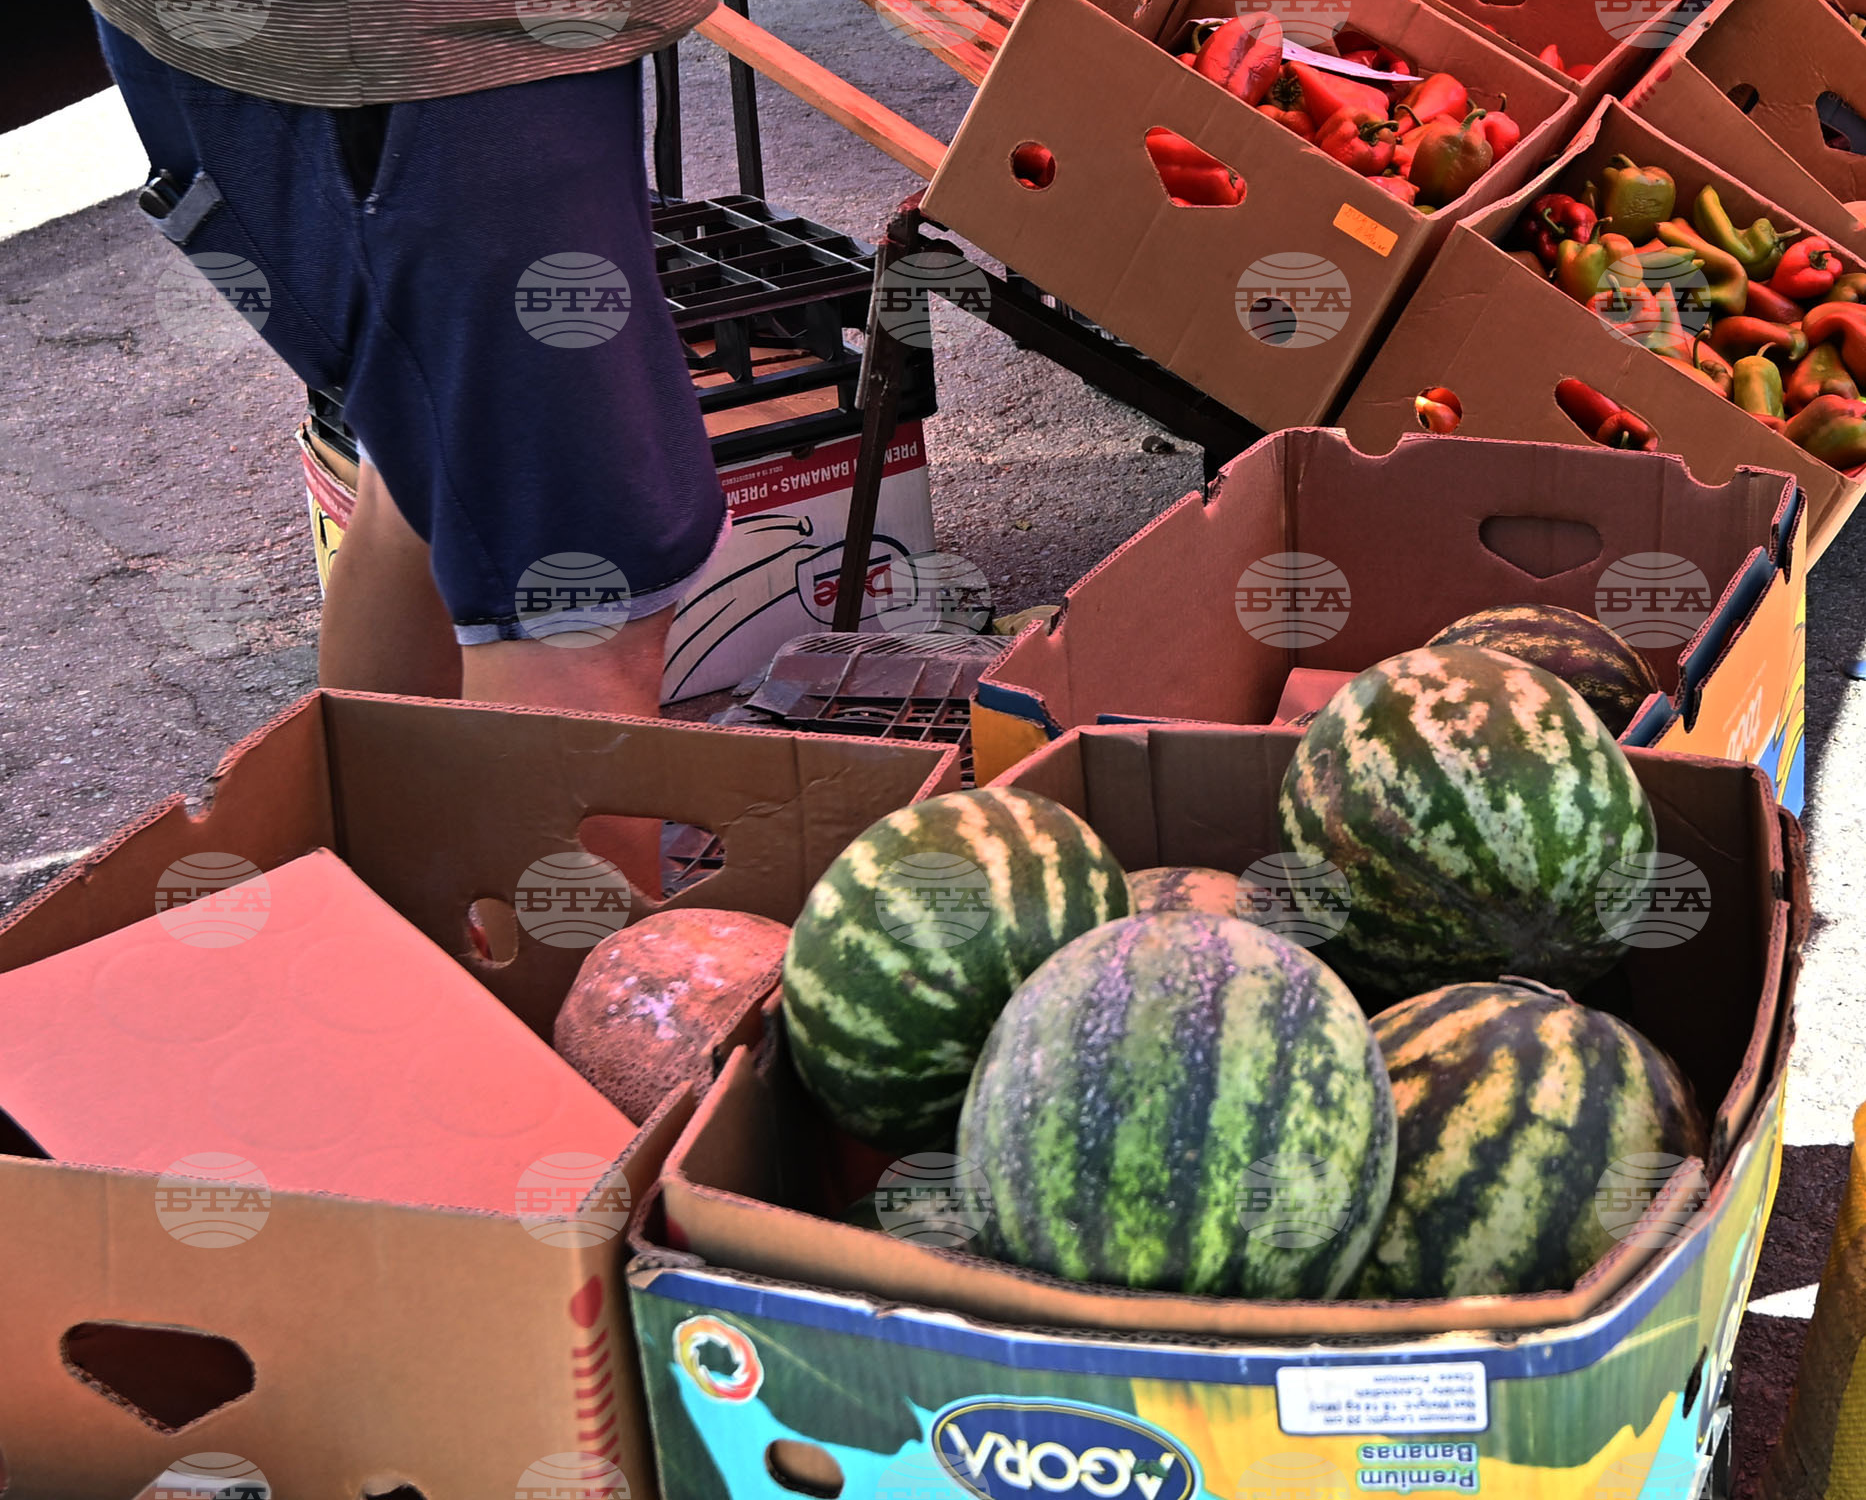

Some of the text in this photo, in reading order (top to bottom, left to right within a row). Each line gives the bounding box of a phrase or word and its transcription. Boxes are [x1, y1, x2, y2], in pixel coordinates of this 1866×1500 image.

[780, 461, 850, 492] BANANAS
[945, 1422, 1177, 1500] AGORA
[1361, 1444, 1474, 1462] Bananas
[1360, 1469, 1475, 1488] Premium
